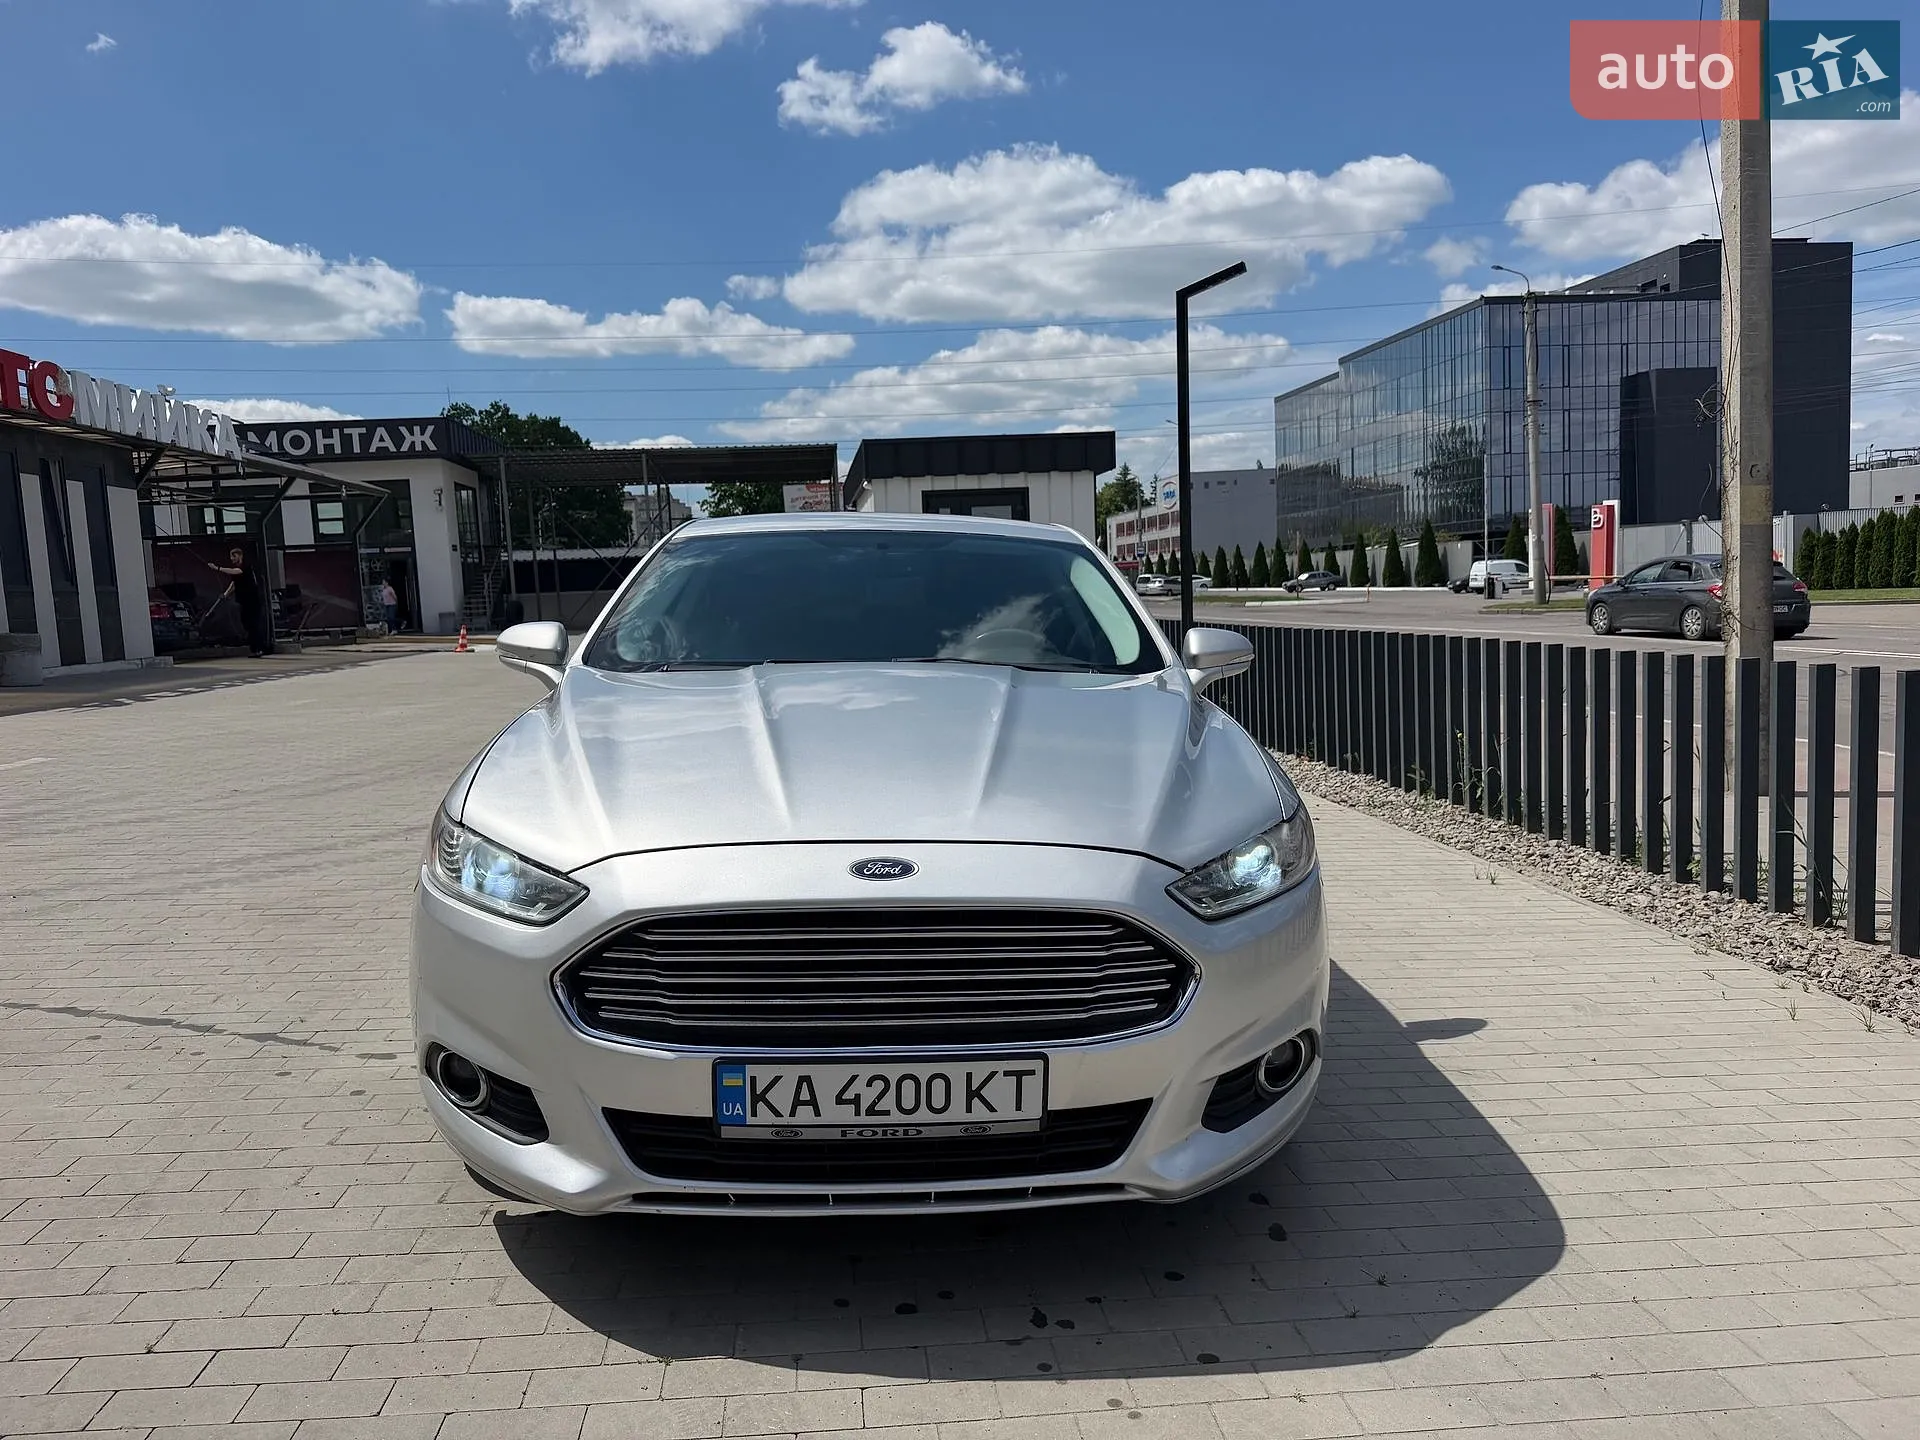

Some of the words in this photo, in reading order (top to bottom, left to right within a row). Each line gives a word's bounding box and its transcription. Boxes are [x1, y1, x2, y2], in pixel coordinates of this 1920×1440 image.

[863, 861, 903, 875] Ford
[749, 1074, 822, 1118] KA
[834, 1072, 953, 1117] 4200
[965, 1069, 1037, 1114] KT
[722, 1102, 744, 1117] UA
[840, 1128, 924, 1138] FORD
